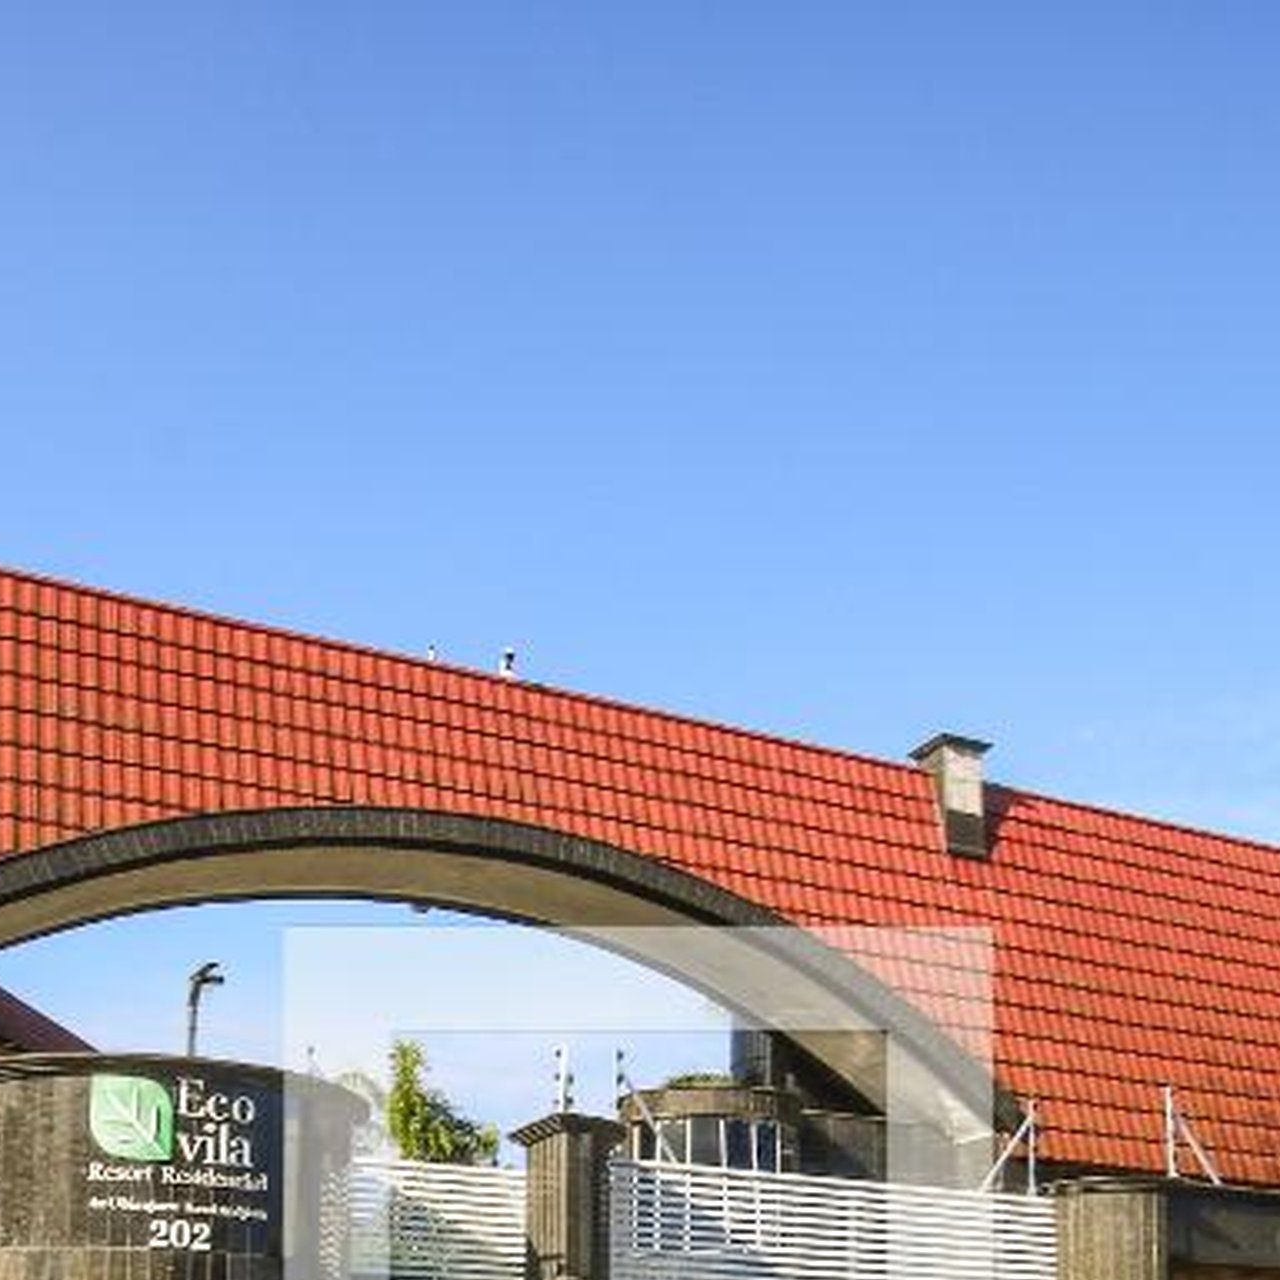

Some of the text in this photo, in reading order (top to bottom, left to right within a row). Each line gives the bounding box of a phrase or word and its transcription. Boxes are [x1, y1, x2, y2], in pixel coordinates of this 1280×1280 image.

[176, 1077, 255, 1123] Eco
[177, 1123, 254, 1167] vila
[86, 1161, 153, 1183] Resort
[148, 1218, 212, 1251] 202
